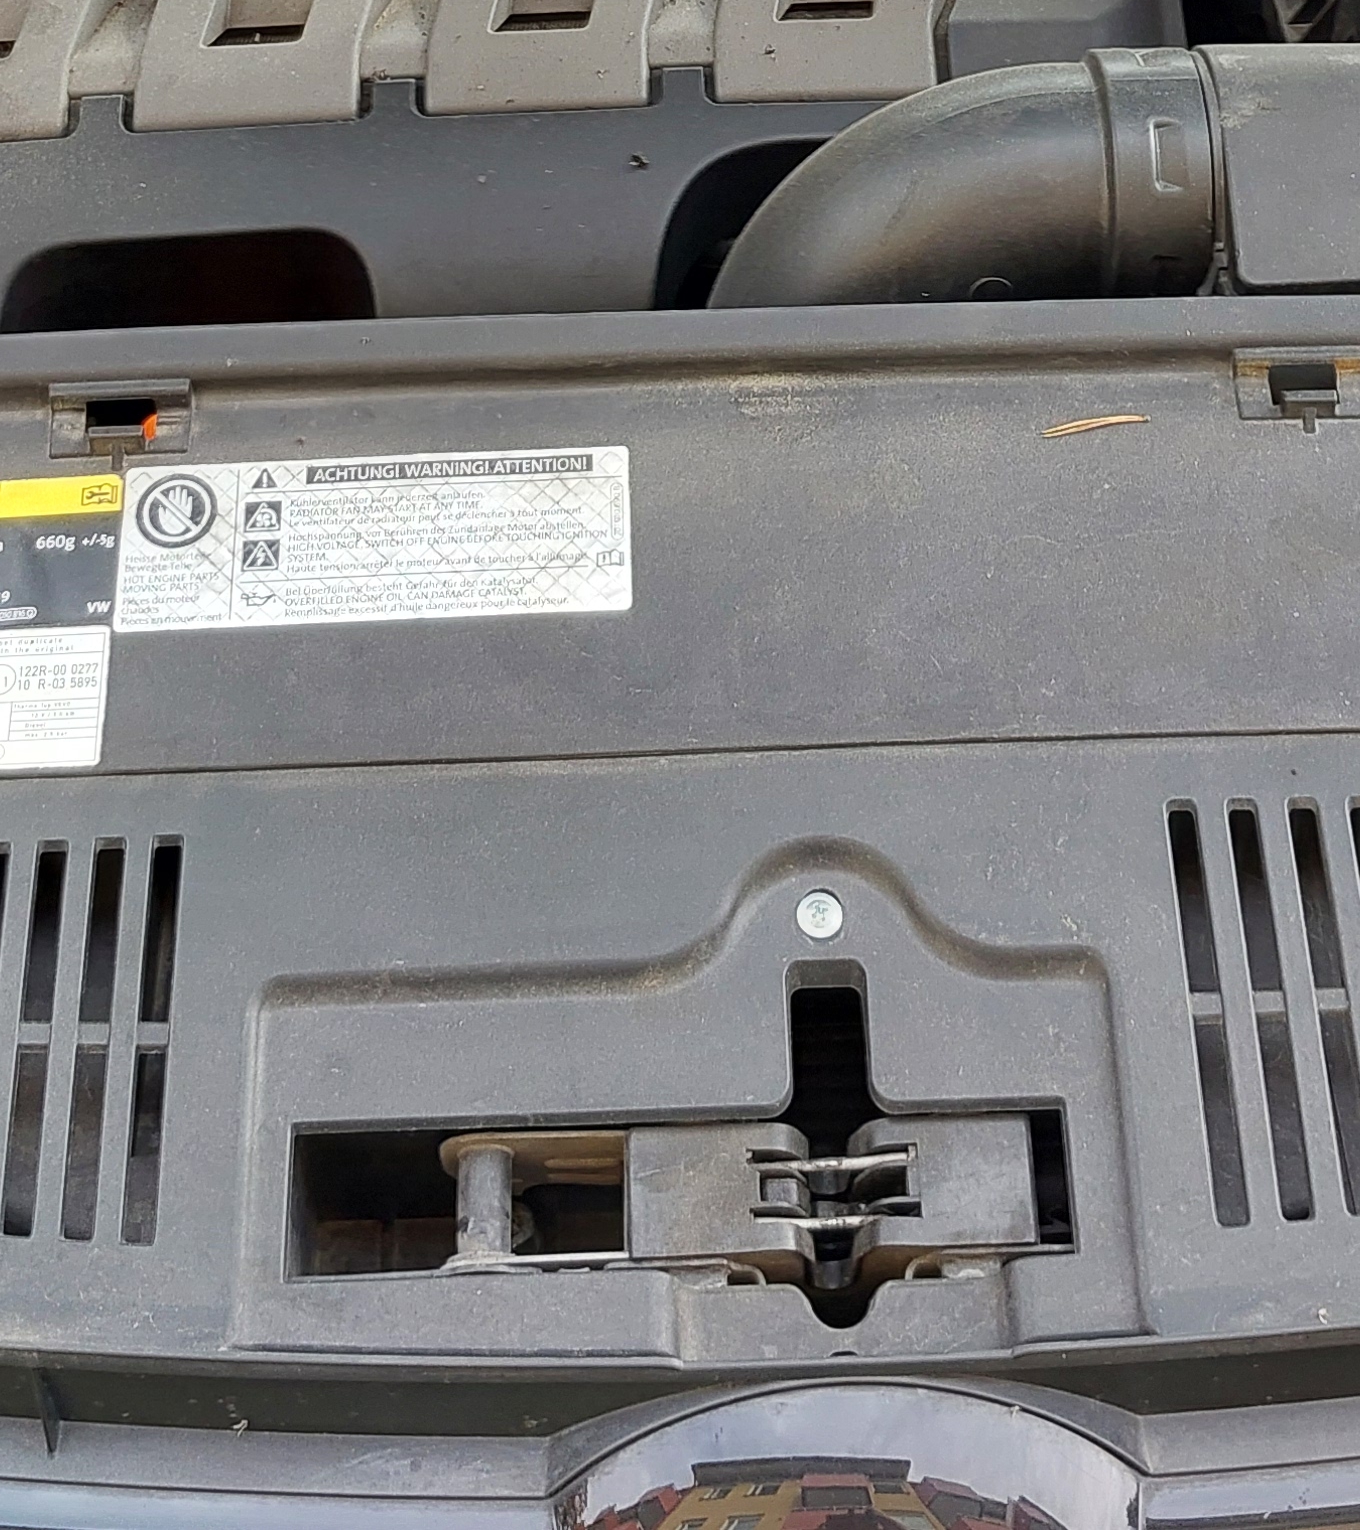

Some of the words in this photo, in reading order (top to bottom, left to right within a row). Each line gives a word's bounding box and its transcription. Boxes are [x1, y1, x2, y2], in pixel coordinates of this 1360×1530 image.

[313, 464, 400, 482] ACHTUNG!
[404, 461, 489, 478] WARNING!
[492, 456, 587, 474] ATTENTION!
[290, 506, 339, 517] RADIATOR
[341, 505, 361, 515] FAN
[363, 504, 387, 515] MAY
[388, 502, 416, 513] START
[418, 502, 433, 511] AT
[434, 501, 454, 511] ANY
[456, 501, 483, 510] TIME.
[302, 515, 355, 526] ventilateur
[357, 513, 370, 523] de
[371, 512, 416, 524] radiateur
[443, 512, 454, 520] se
[517, 507, 538, 517] tout
[366, 529, 381, 538] vor
[507, 522, 537, 532] Motor
[36, 535, 76, 551] 660g
[81, 533, 115, 549] +/-5g
[288, 542, 314, 553] HIGH
[366, 538, 404, 549] SWITCH
[406, 537, 425, 546] OFF
[428, 534, 466, 545] ENGINE
[467, 533, 504, 544] BEFORE
[506, 532, 560, 542] TOUCHING
[561, 530, 607, 540] IGNITION
[125, 564, 167, 573] Bewegte
[287, 563, 317, 573] Haute
[396, 559, 405, 567] le
[406, 558, 442, 568] moteur
[445, 555, 472, 565] avant
[474, 554, 486, 563] de
[488, 552, 526, 563] toucher
[124, 575, 145, 584] HOT
[148, 574, 187, 583] ENGINE
[190, 571, 220, 582] PARTS
[366, 582, 403, 592] besteht
[406, 580, 441, 590] Gefahr
[460, 578, 479, 587] den
[123, 584, 166, 593] MOVING
[170, 582, 200, 591] PARTS
[152, 595, 165, 604] du
[166, 594, 200, 604] moteur
[285, 595, 343, 606] OVERFILLED
[346, 593, 384, 604] ENGINE
[386, 592, 403, 601] OIL
[407, 590, 430, 600] CAN
[431, 588, 476, 599] DAMAGE
[86, 601, 112, 613] VW
[121, 606, 159, 615] chaudes
[285, 606, 346, 619] Remplissage
[348, 604, 388, 614] excessif
[425, 601, 478, 612] dangereux
[480, 600, 505, 611] pour
[507, 597, 515, 606] le
[18, 637, 63, 646] duplicate
[35, 644, 74, 654] original
[19, 664, 67, 678] 122R-00
[72, 662, 99, 675] 0277
[18, 679, 30, 691] 10
[38, 677, 66, 690] R-03
[70, 675, 98, 688] 5895
